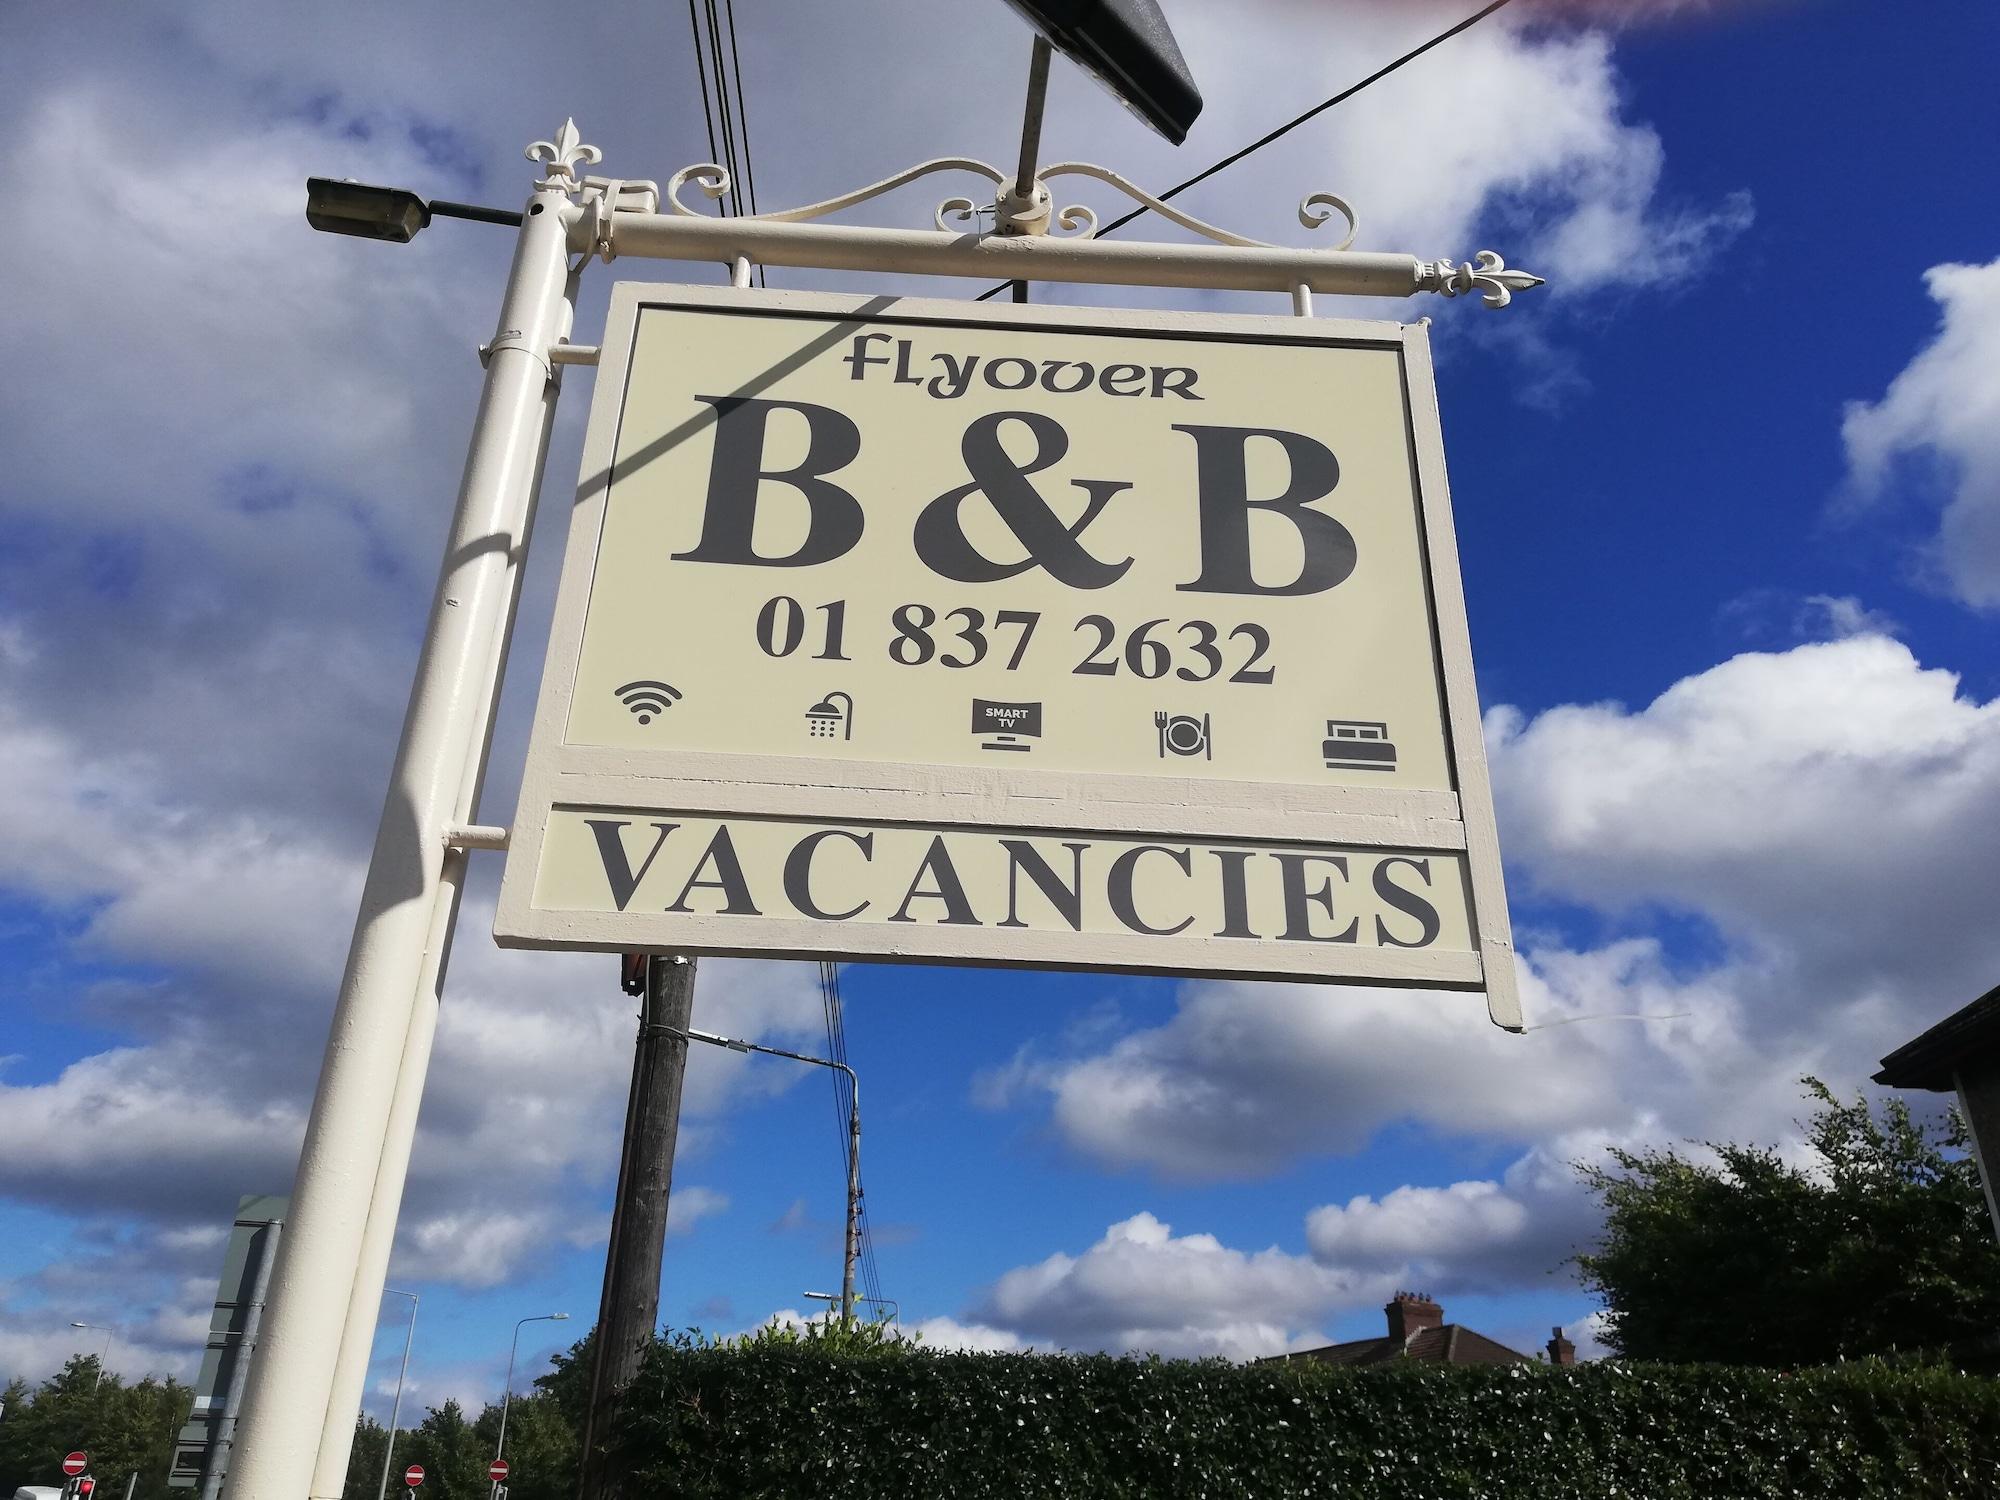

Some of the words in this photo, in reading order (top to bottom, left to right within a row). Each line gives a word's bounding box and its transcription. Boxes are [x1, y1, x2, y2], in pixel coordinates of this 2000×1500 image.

[671, 395, 864, 567] B
[914, 411, 1135, 590] &
[1172, 424, 1357, 596] B
[757, 596, 851, 660] 01
[889, 604, 1041, 670] 837
[1072, 615, 1275, 684] 2632
[985, 708, 1029, 719] SMART
[998, 718, 1015, 728] TV
[584, 820, 1440, 947] VACANCIES
